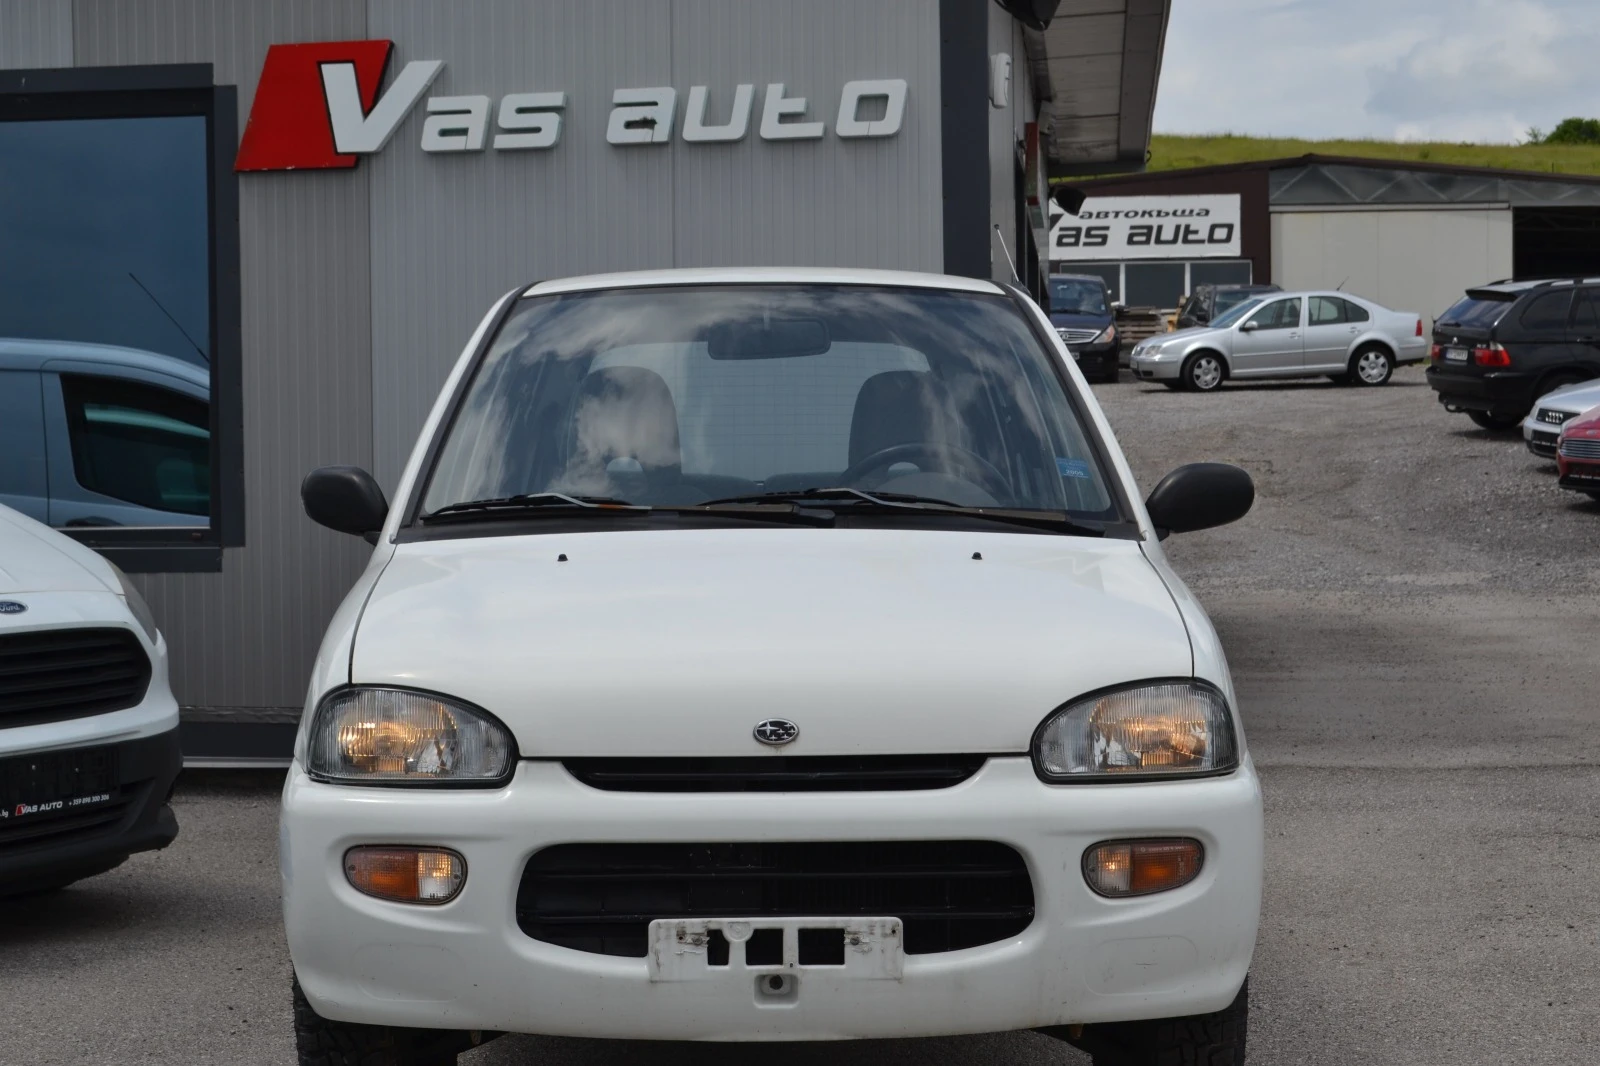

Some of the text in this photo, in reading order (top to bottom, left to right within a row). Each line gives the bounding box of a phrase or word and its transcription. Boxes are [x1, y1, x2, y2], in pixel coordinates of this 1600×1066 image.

[318, 59, 908, 154] Vas auto
[1079, 208, 1211, 220] автокъша
[1126, 223, 1235, 246] auto
[39, 801, 63, 811] AUTO
